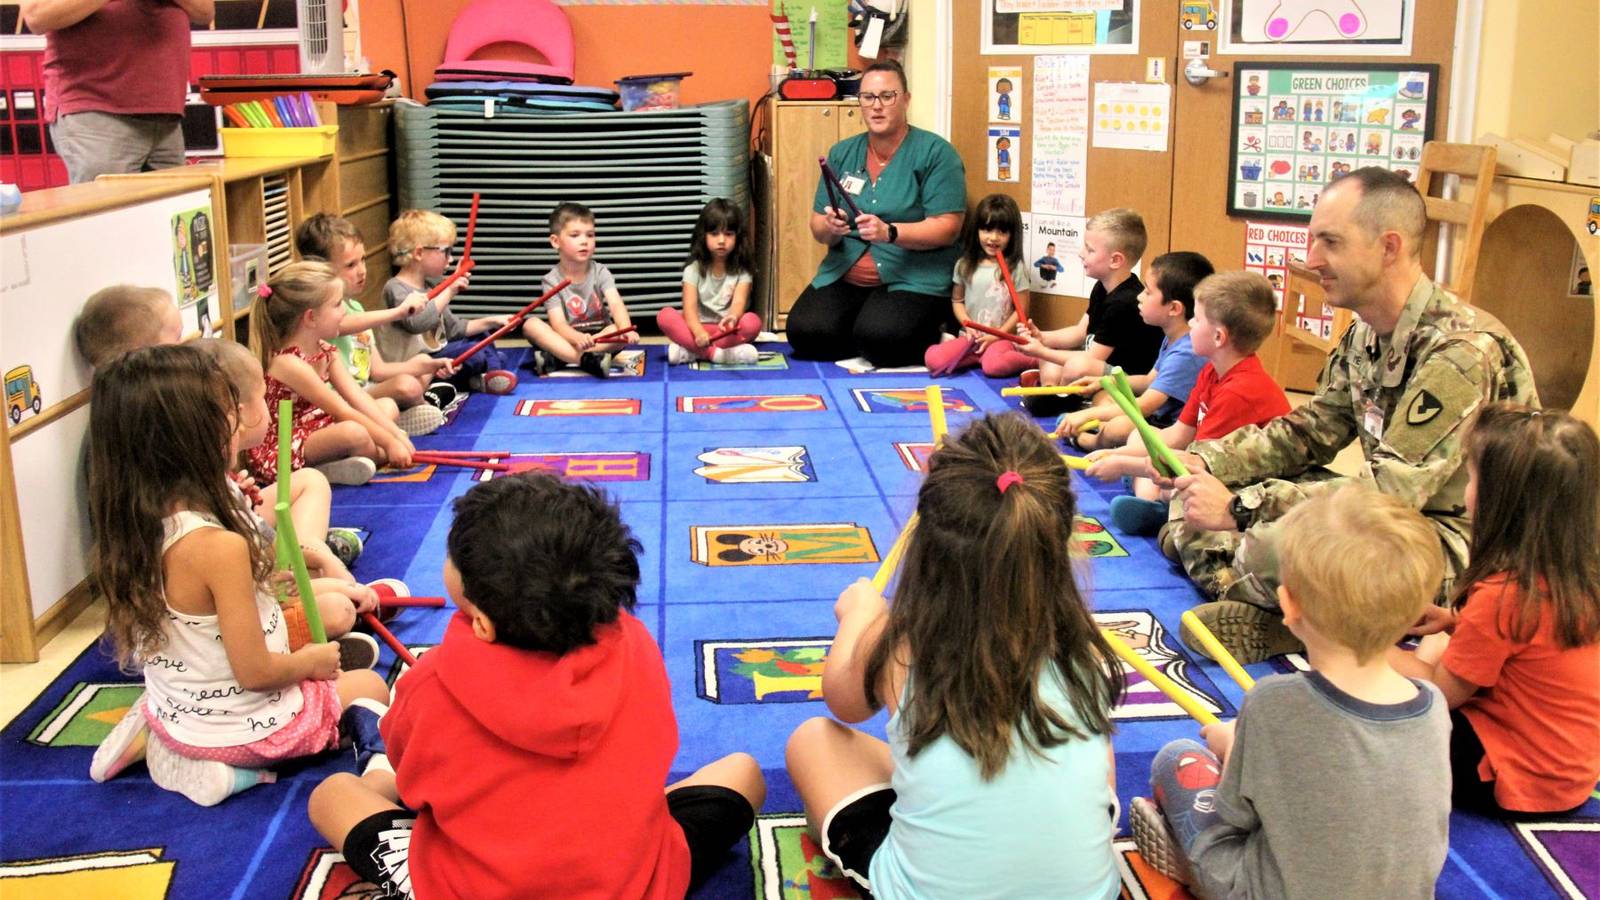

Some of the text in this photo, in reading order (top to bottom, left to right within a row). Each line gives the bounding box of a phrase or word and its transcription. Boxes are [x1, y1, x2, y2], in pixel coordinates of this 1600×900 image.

[1292, 77, 1366, 90] GREEN CHOICES
[1037, 225, 1079, 238] Mountain
[1248, 227, 1306, 245] RED CHOICES
[564, 458, 639, 477] H
[780, 530, 870, 561] M
